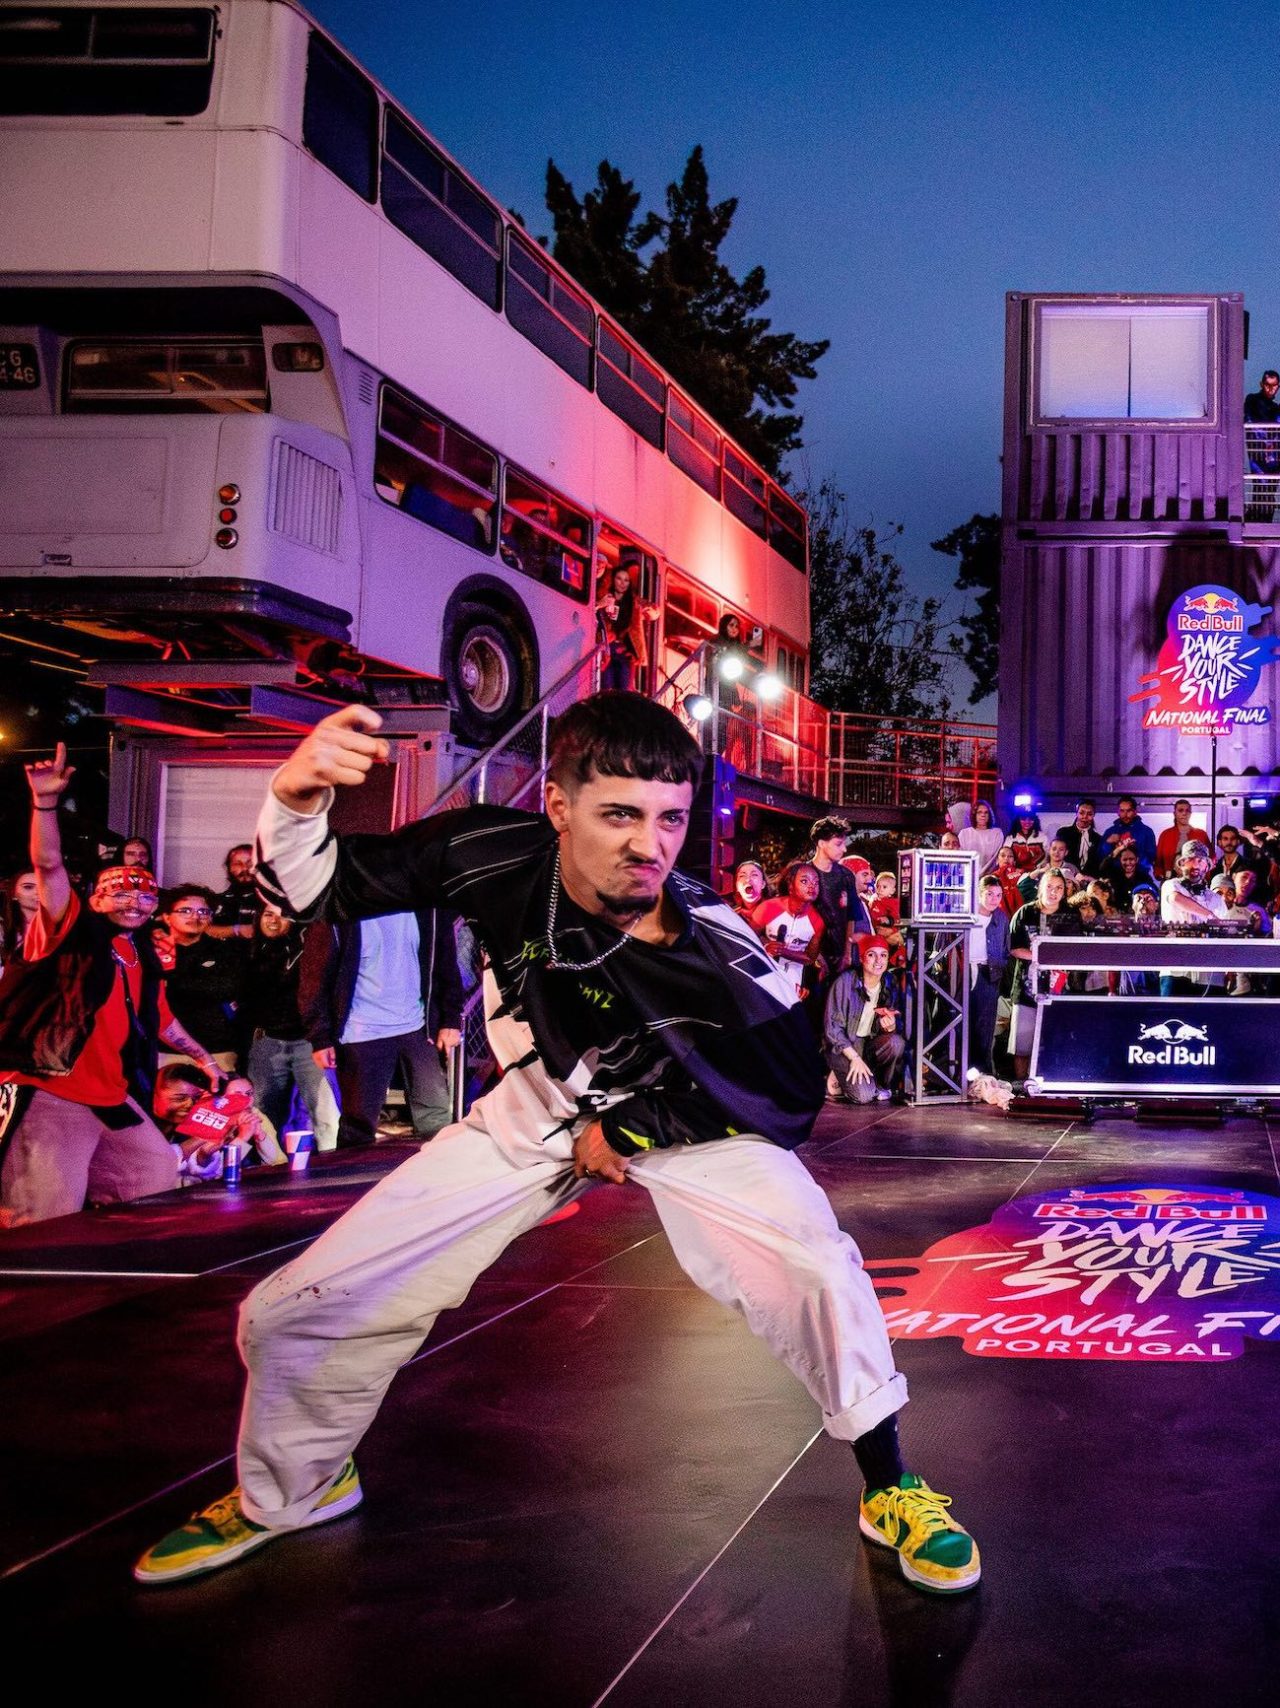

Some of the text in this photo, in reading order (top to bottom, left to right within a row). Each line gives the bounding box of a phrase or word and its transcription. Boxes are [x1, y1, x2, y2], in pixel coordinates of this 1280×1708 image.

[1178, 614, 1243, 632] Red Bull
[1178, 632, 1242, 661] DANCE
[1182, 652, 1248, 681] YOUR
[1178, 668, 1240, 706] STYLE
[1146, 707, 1267, 726] NATIONAL FINAL
[1181, 726, 1230, 734] PORTUGAL
[1128, 1045, 1216, 1066] Red Bull
[1033, 1203, 1267, 1220] Red Bull
[1012, 1220, 1264, 1248] DANCE
[986, 1257, 1270, 1306] STYLE
[975, 1338, 1232, 1356] PORTUGAL
